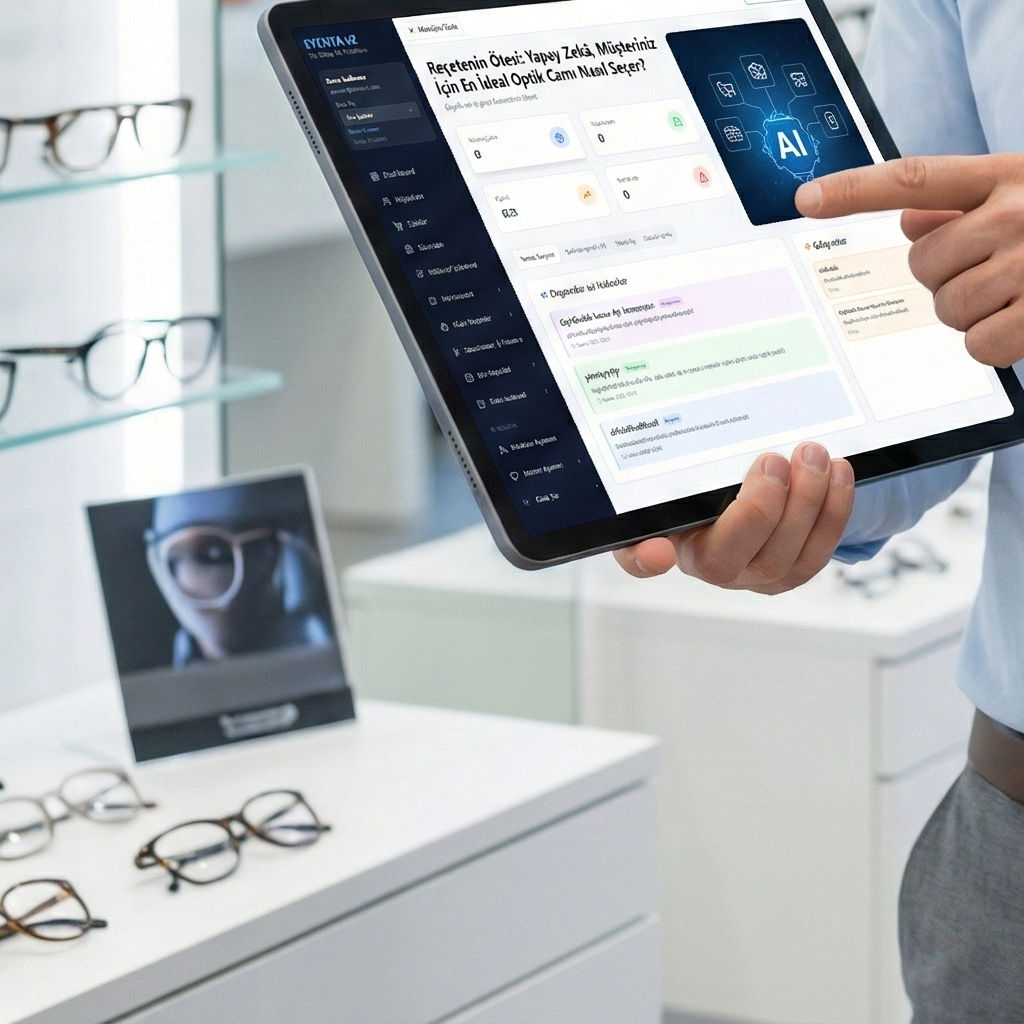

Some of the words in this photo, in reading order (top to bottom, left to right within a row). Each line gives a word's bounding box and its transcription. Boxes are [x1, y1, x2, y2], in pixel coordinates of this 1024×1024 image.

[426, 55, 488, 77] Reçetenin
[488, 50, 525, 68] Ötesi:
[595, 36, 657, 57] Müşteriniz
[433, 77, 460, 98] İçin
[460, 78, 477, 92] En
[476, 73, 510, 90] İdeal
[510, 69, 546, 90] Optik
[546, 68, 577, 83] Camı
[608, 58, 646, 77] Seçer?
[776, 129, 808, 160] AI
